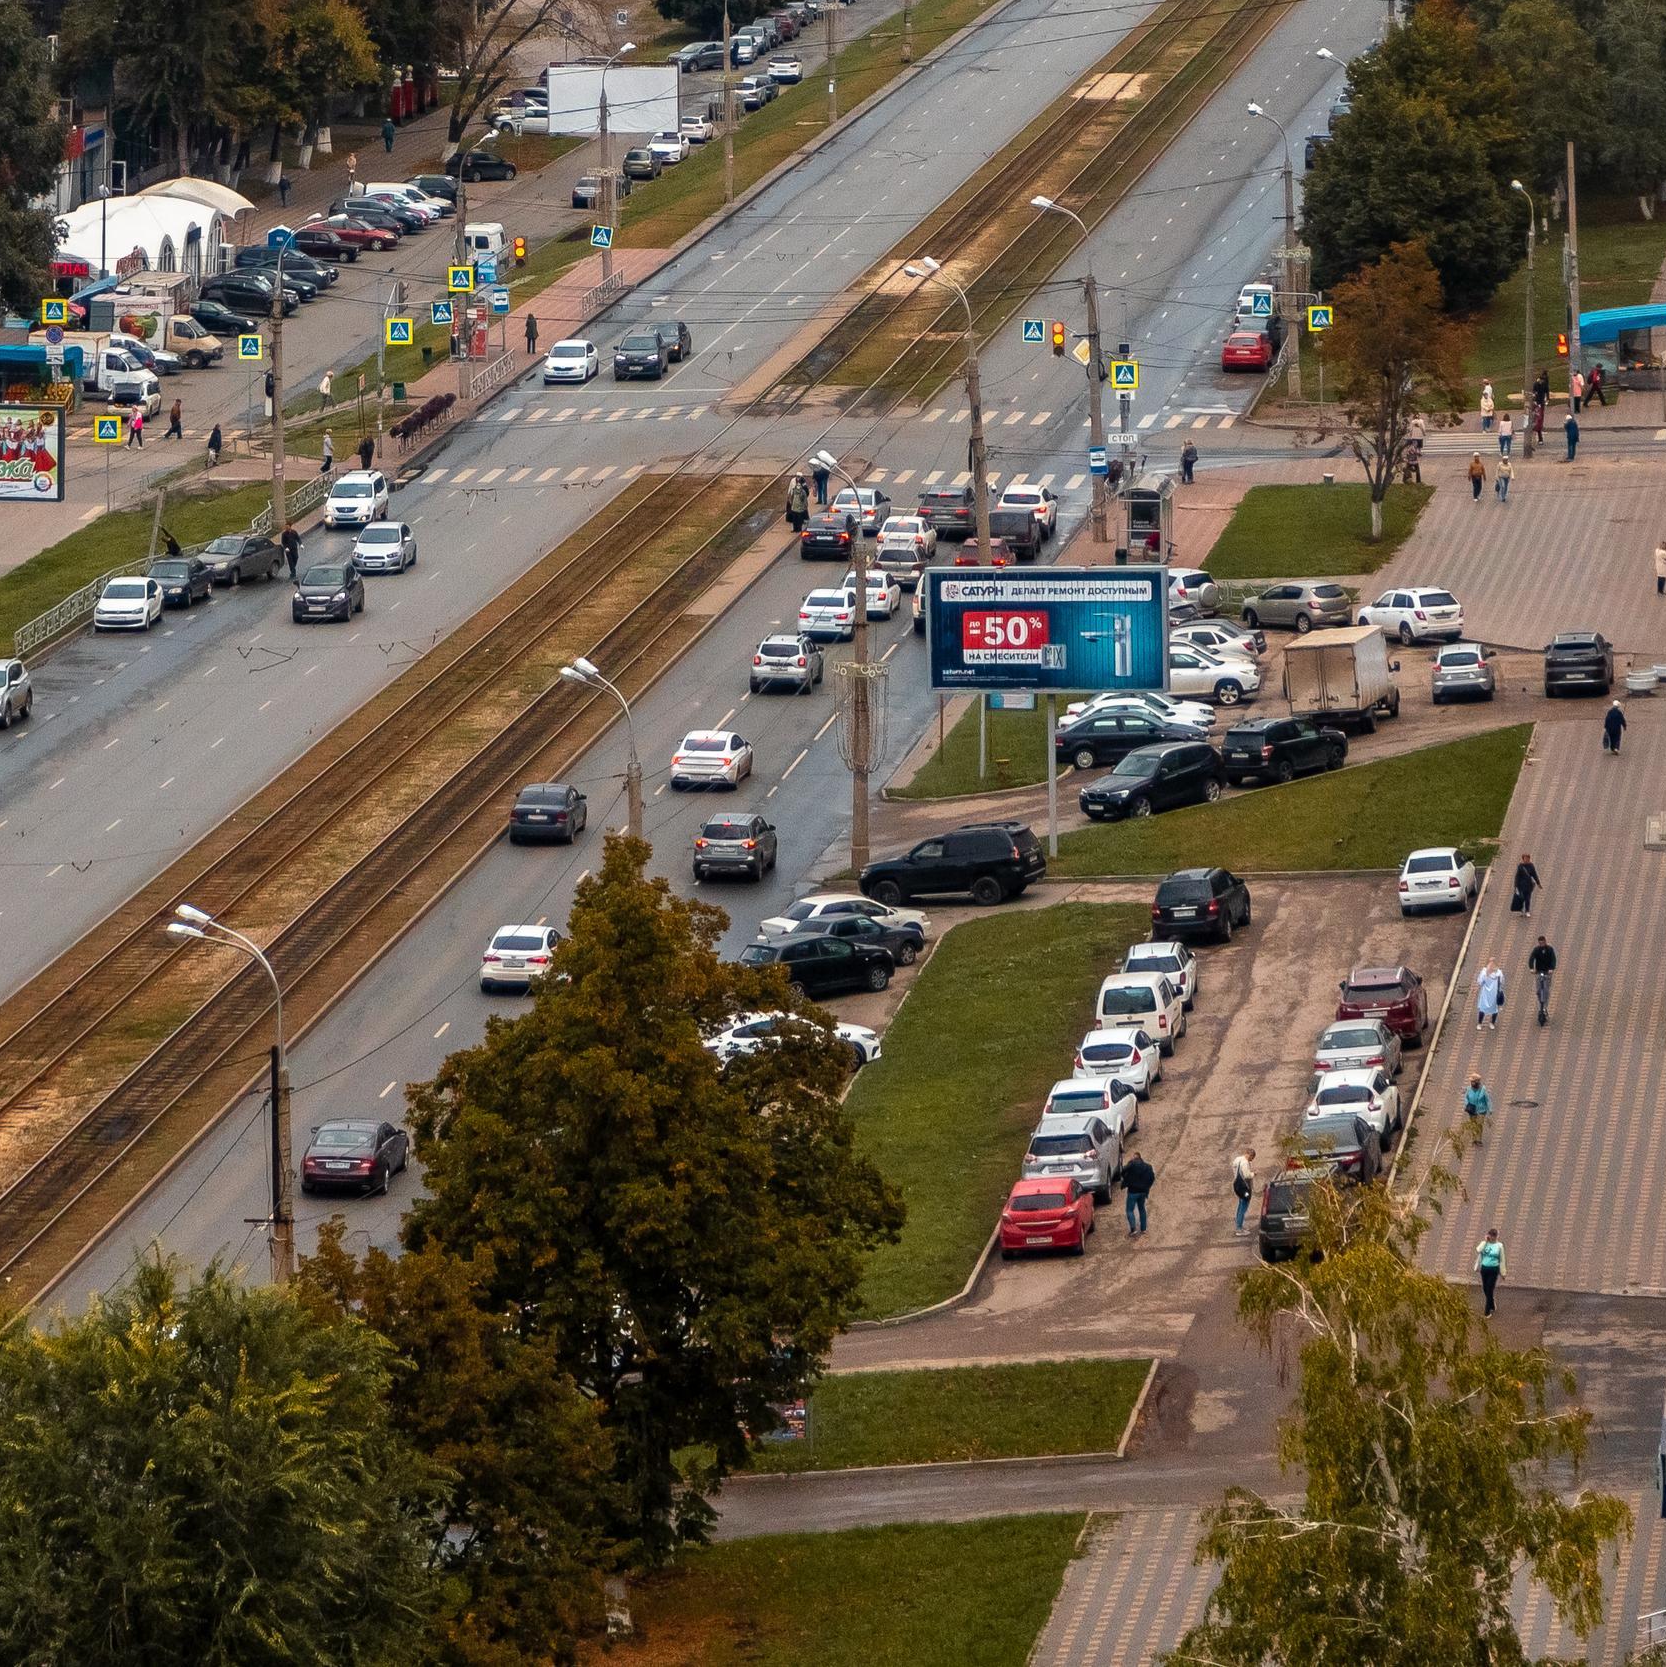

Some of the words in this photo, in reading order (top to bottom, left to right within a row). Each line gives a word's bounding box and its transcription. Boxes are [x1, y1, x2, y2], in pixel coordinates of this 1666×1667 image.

[961, 586, 1004, 596] САТУРН
[1011, 587, 1046, 596] ДЕЛАЕТ
[1048, 587, 1085, 595] РЕМОНТ
[1088, 587, 1147, 596] ДОСТУПНЫМ
[984, 653, 1039, 661] СМЕСИТЕЛИ
